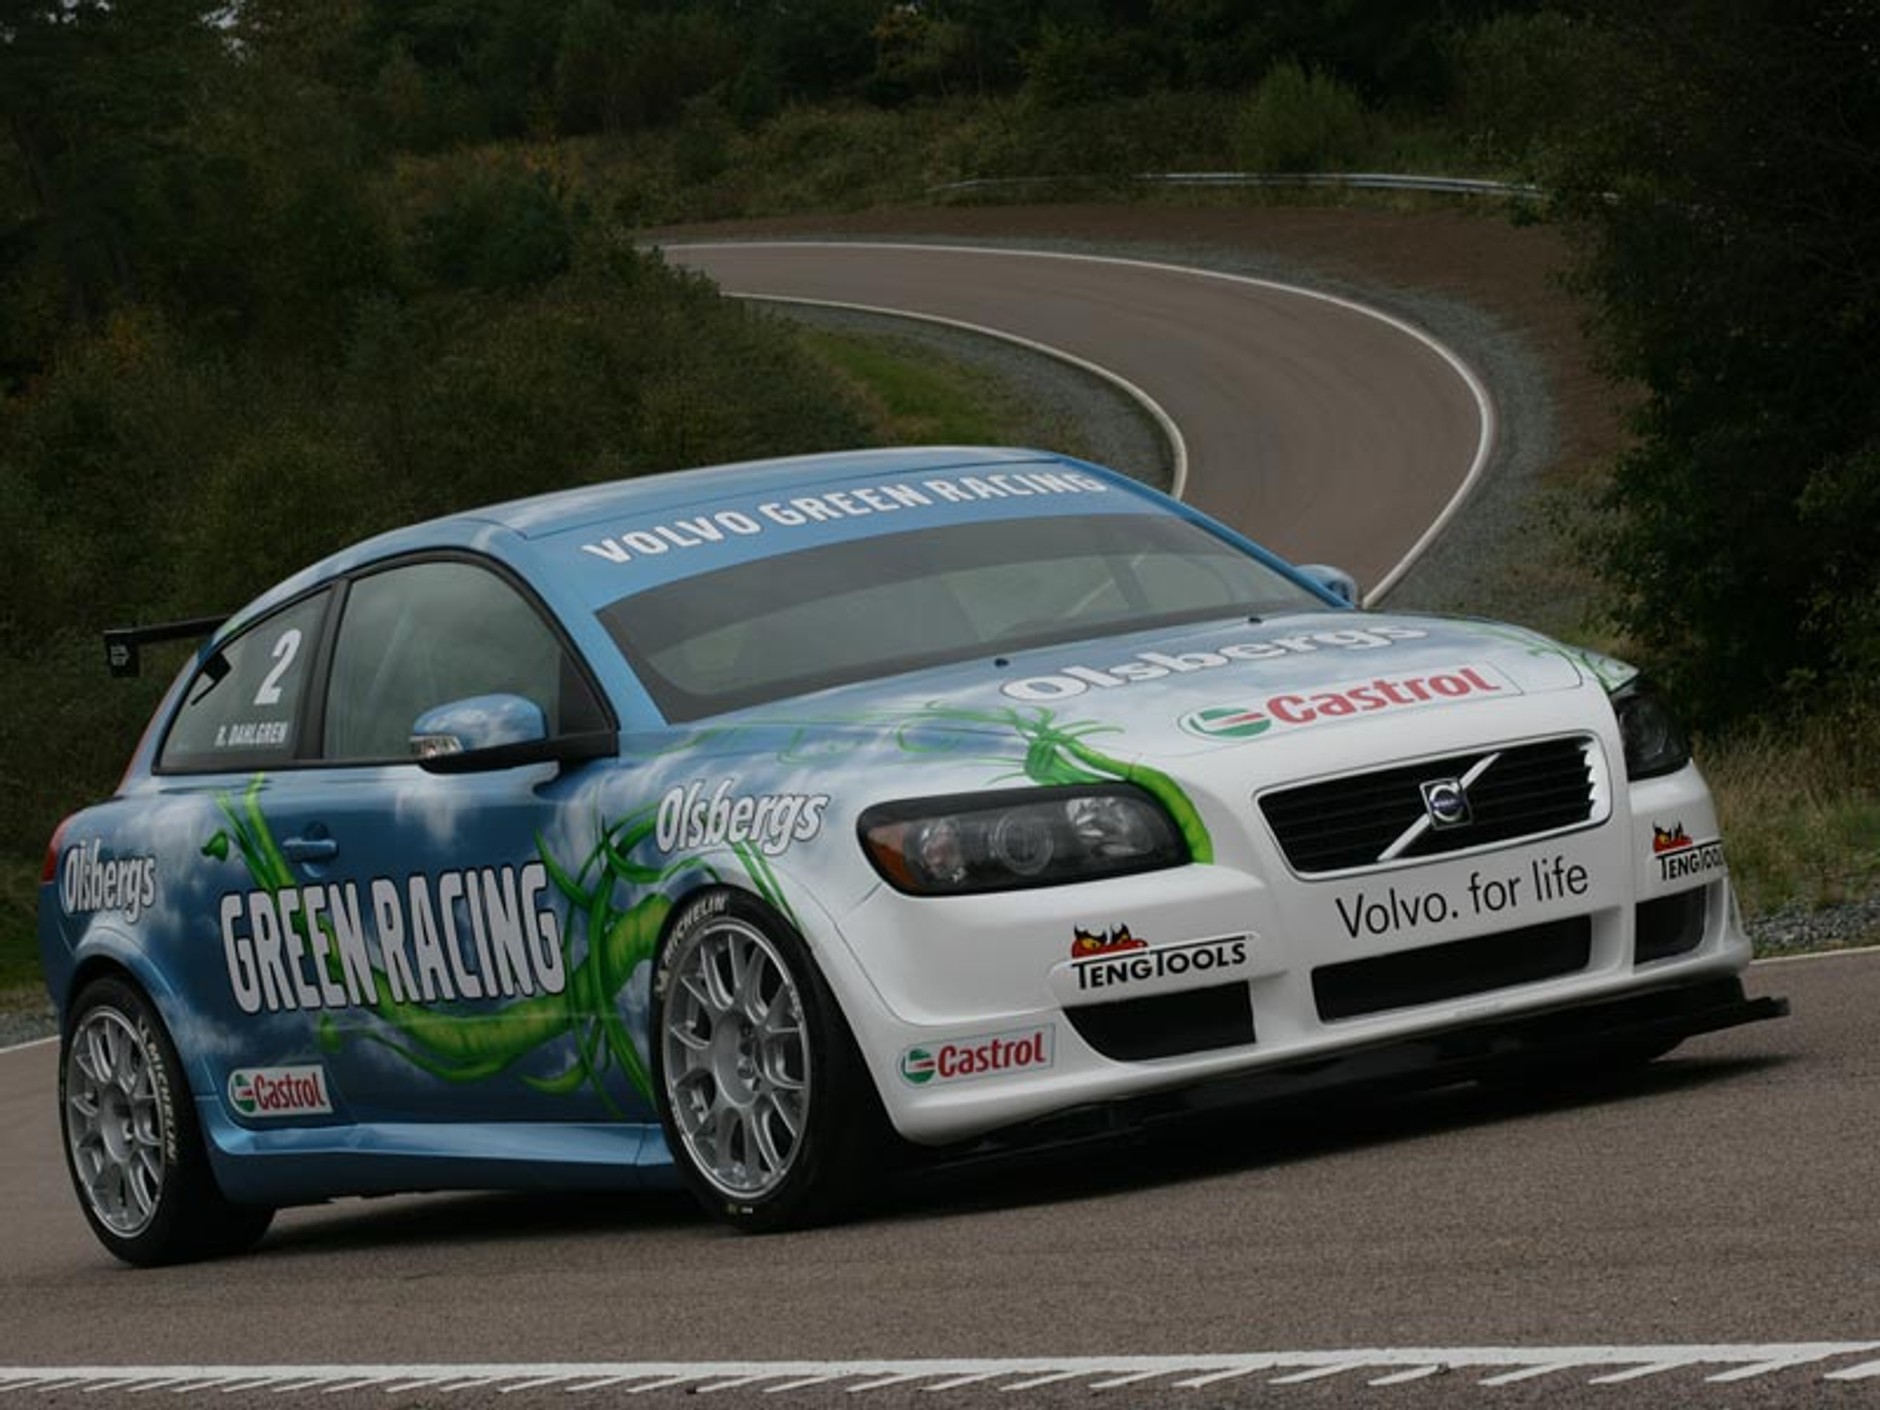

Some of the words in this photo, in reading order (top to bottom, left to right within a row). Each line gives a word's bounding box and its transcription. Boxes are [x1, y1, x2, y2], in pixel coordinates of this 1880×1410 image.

[582, 510, 761, 564] VOLVO
[758, 484, 932, 527] GREEN
[922, 471, 1108, 502] RACING
[253, 628, 301, 706] 2
[1000, 624, 1430, 700] Olsbergs
[1265, 667, 1499, 726] Castrol
[655, 777, 830, 856] Olsbergs
[62, 837, 156, 924] Olsbergs
[1336, 888, 1459, 939] Volvo.
[1468, 872, 1521, 914] for
[1532, 855, 1590, 902] life
[219, 880, 379, 1014] GREEN
[371, 860, 567, 1005] RACING
[254, 1072, 326, 1111] Castrol
[937, 1032, 1045, 1078] Castrol
